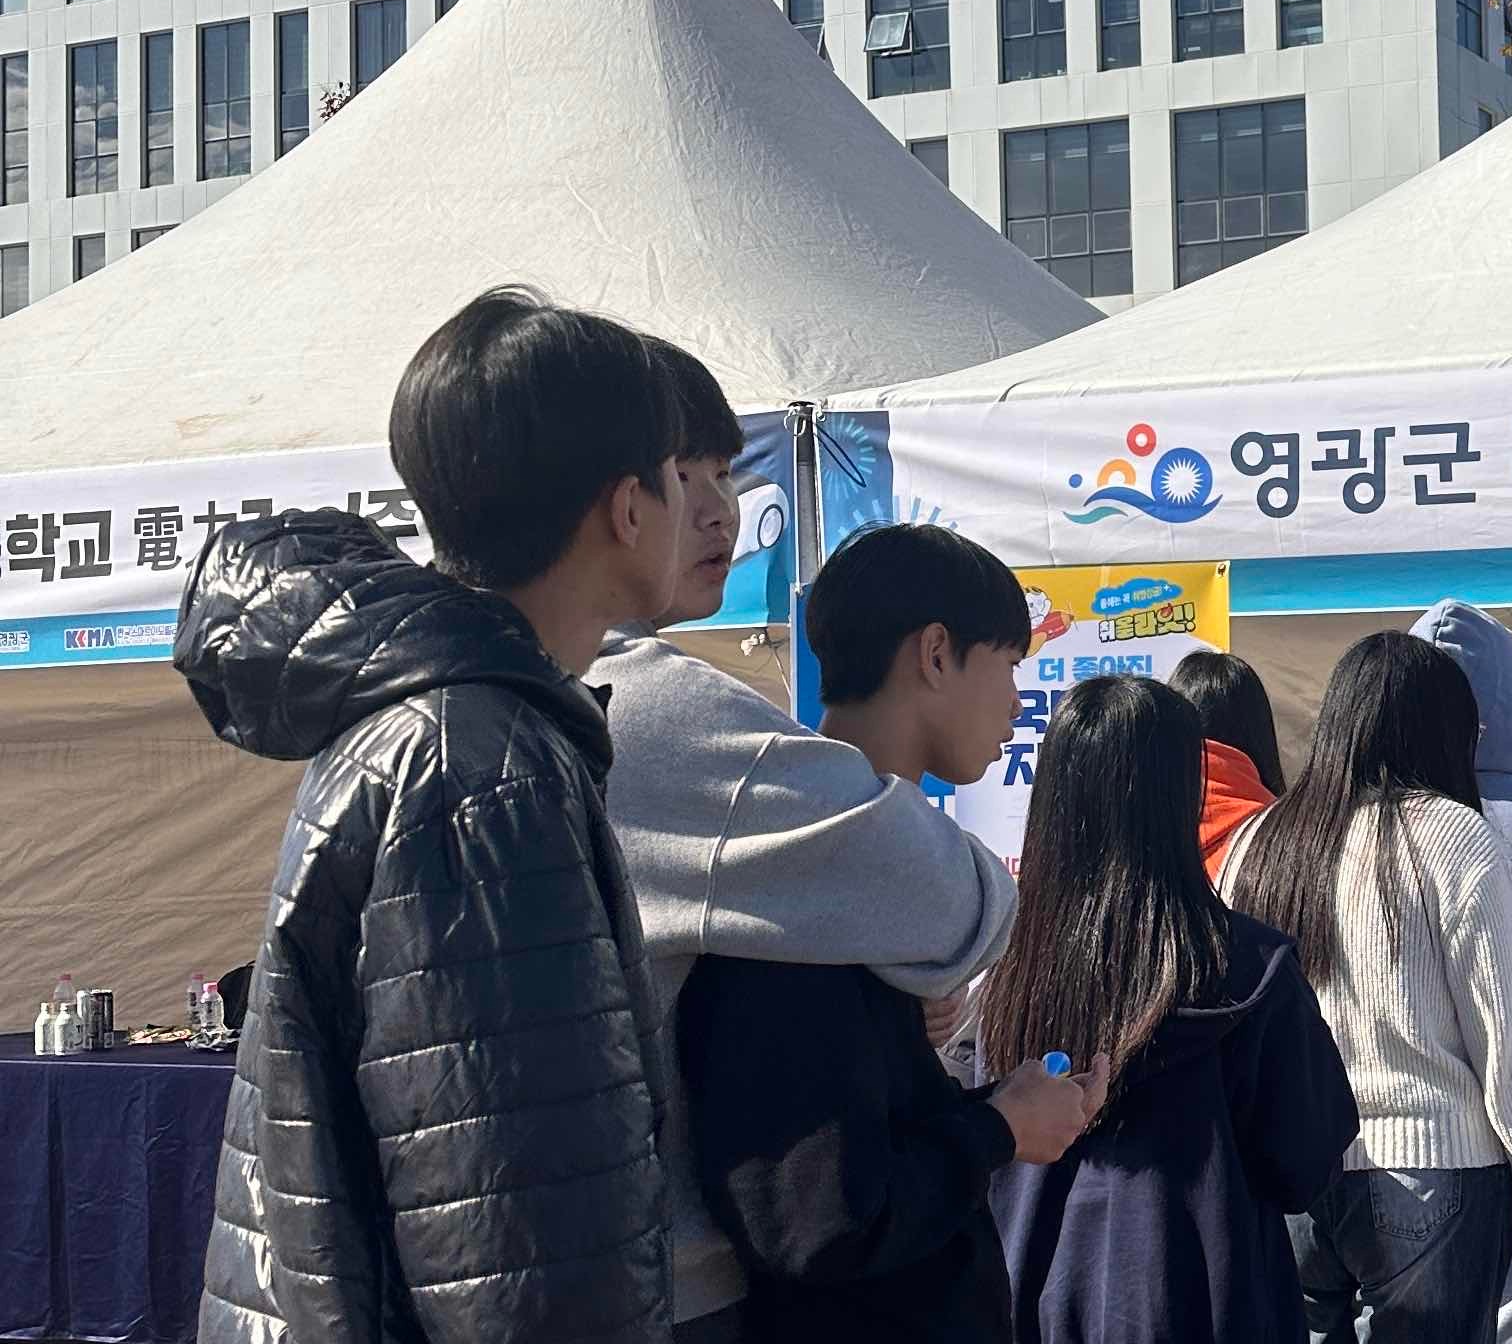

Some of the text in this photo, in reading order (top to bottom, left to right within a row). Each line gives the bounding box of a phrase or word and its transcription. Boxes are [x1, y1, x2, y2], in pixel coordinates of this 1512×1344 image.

[1230, 422, 1481, 519] 영광군
[0, 509, 112, 582] 학교
[1038, 657, 1065, 682] 더
